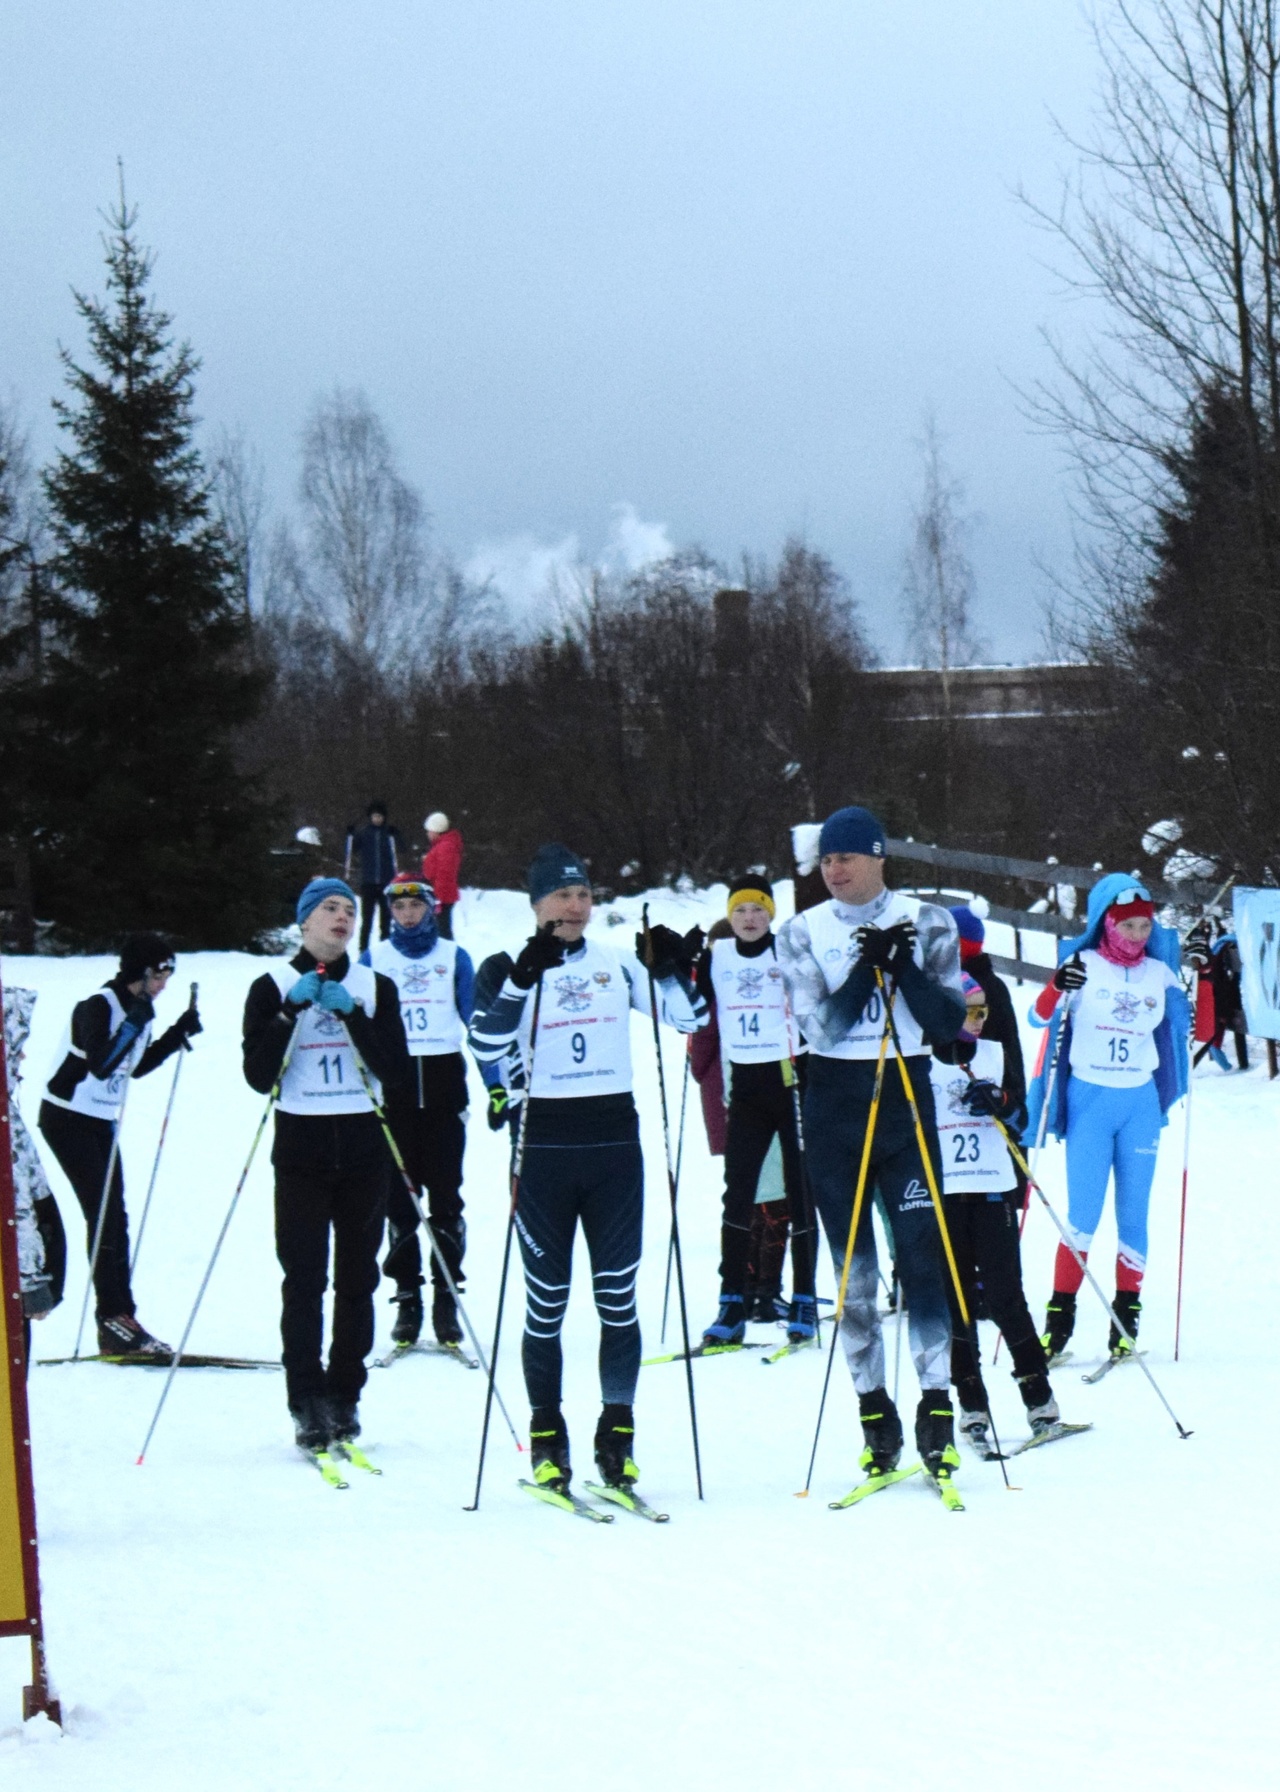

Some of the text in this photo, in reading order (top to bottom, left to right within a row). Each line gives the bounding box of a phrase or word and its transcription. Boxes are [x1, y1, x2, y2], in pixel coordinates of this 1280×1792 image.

[403, 1007, 429, 1032] 13
[738, 1013, 760, 1037] 14
[570, 1032, 586, 1064] 9
[1108, 1037, 1129, 1063] 15
[318, 1054, 343, 1084] 11
[952, 1133, 980, 1163] 23
